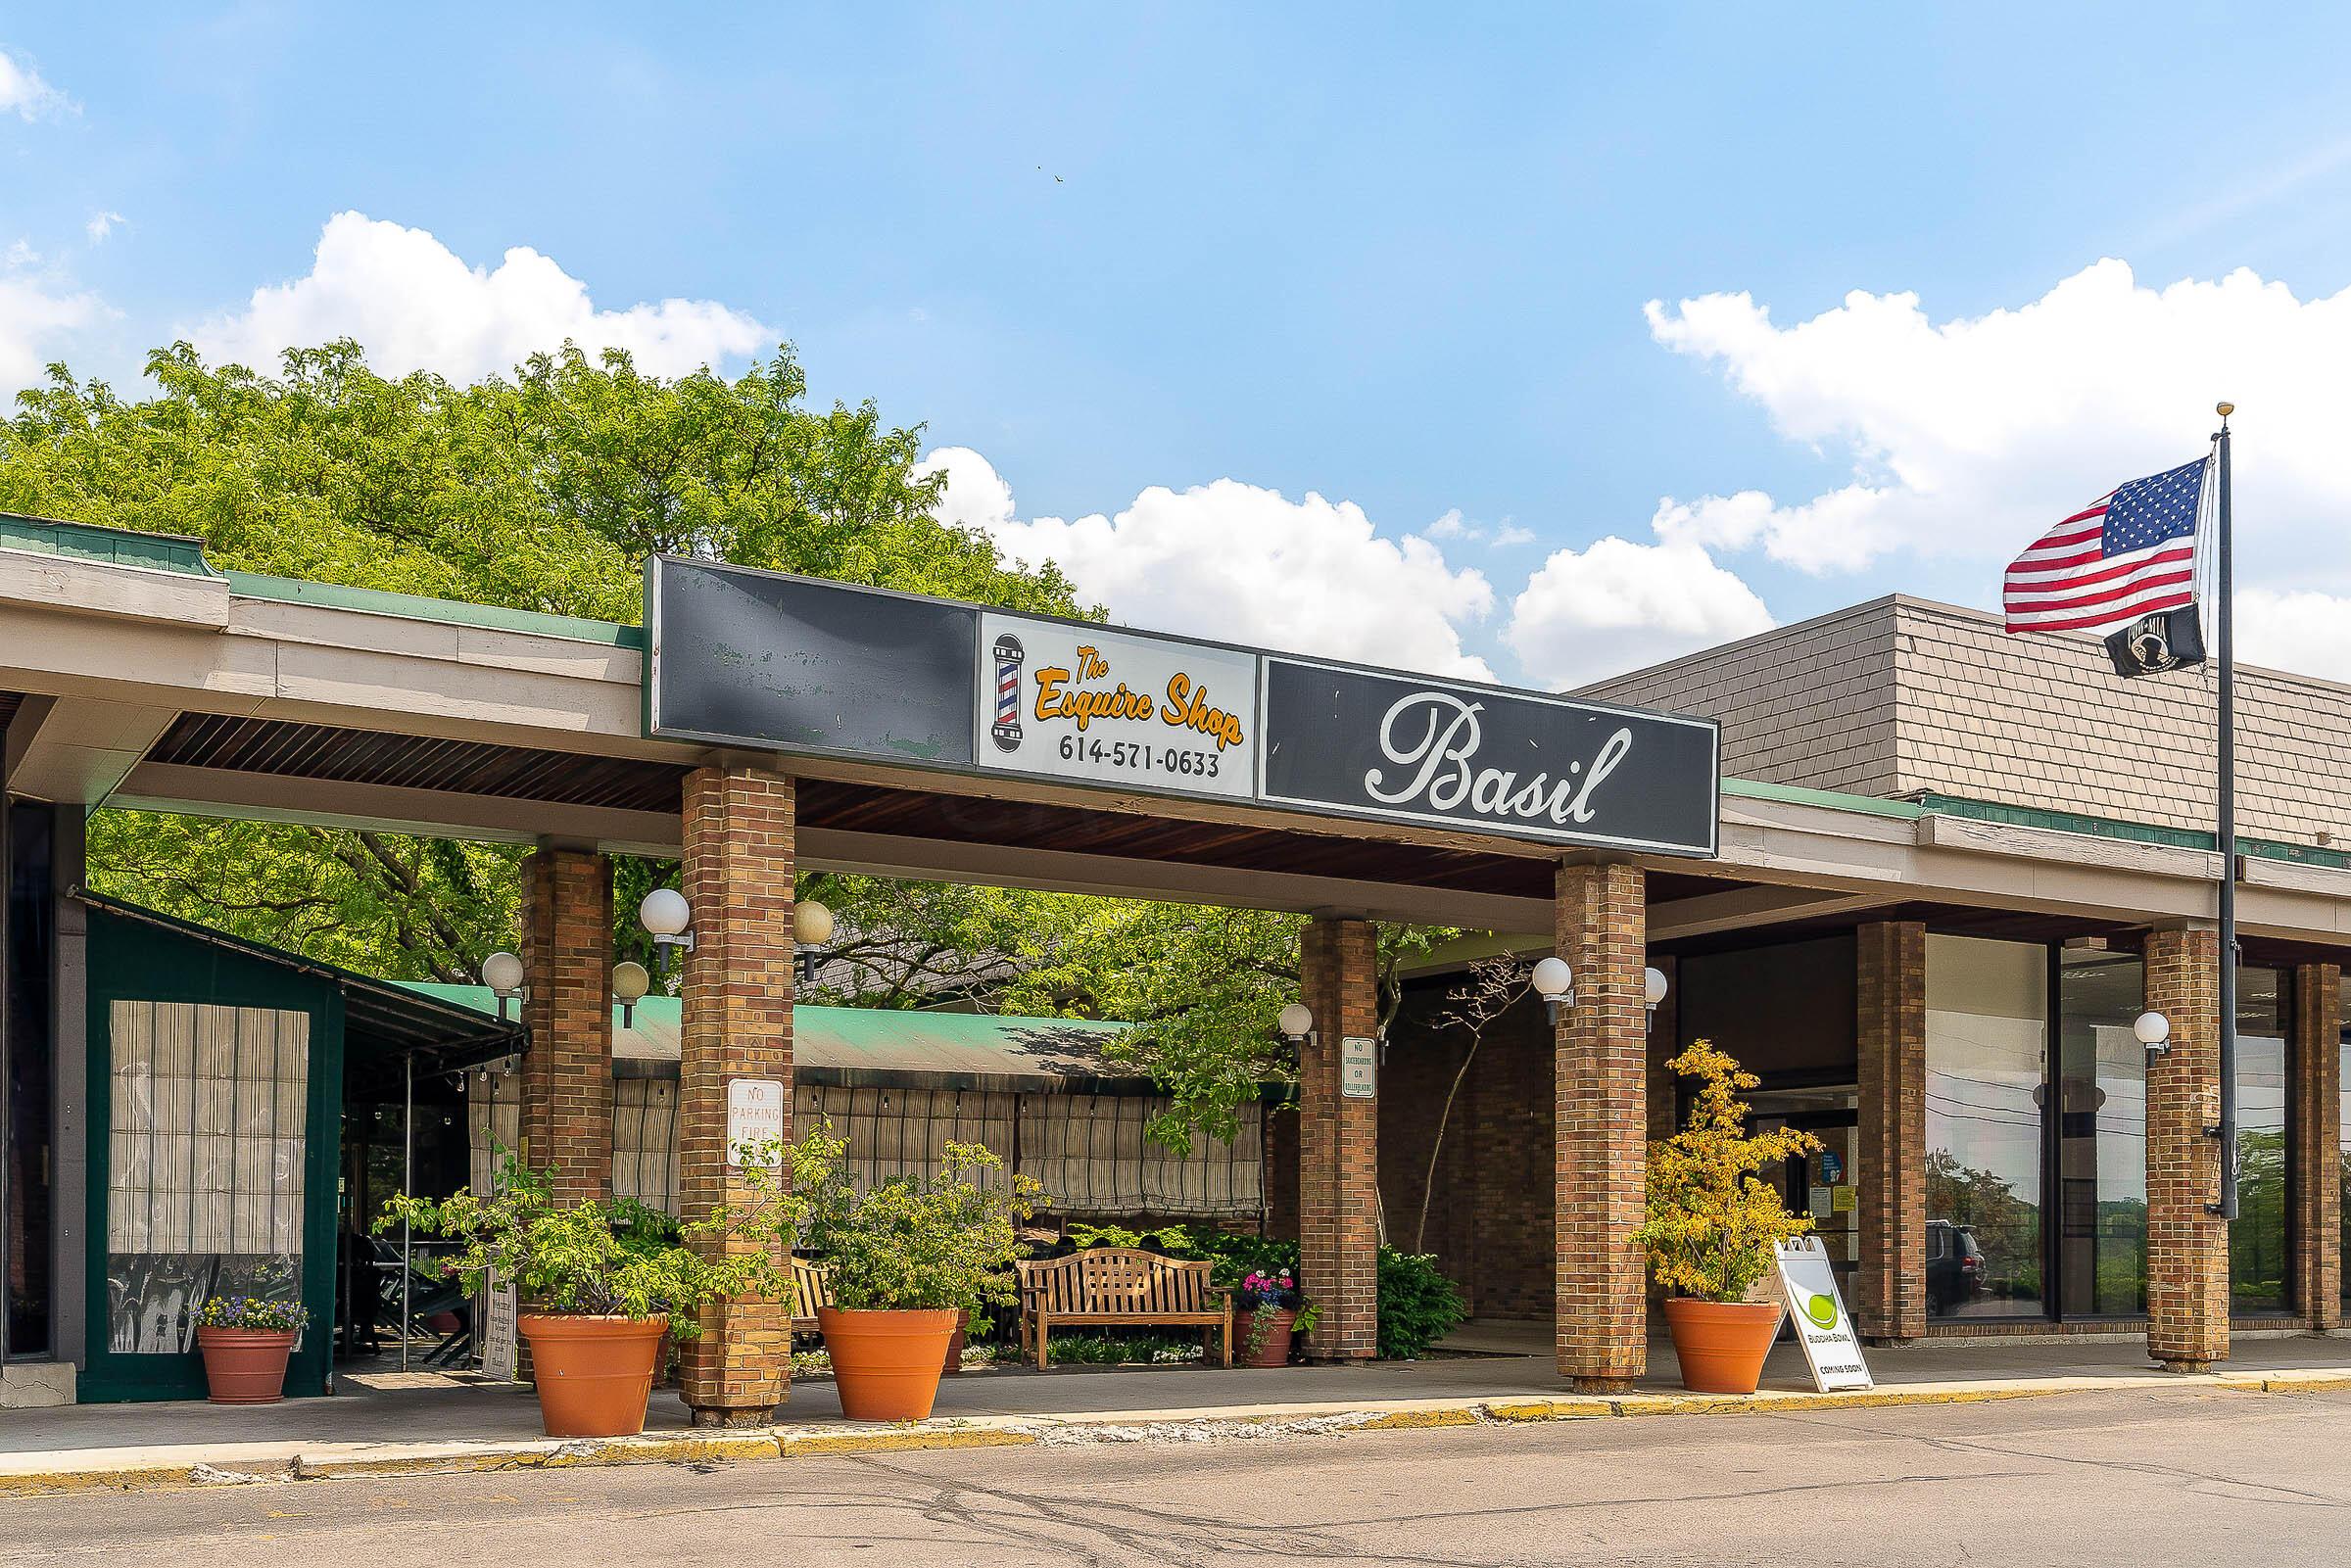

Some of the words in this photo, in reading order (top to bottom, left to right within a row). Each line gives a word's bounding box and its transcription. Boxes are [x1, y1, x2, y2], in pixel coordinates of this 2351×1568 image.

[1077, 644, 1109, 684] The
[1034, 666, 1154, 732] Esquire
[1160, 672, 1244, 751] Shop
[1059, 734, 1220, 779] 614-571-0633
[1365, 691, 1633, 825] Basil
[1355, 1043, 1363, 1052] NO
[1354, 1069, 1364, 1078] OR
[747, 1088, 764, 1102] NO
[733, 1107, 779, 1120] PARKING
[742, 1126, 769, 1139] FIRE
[1833, 1333, 1851, 1343] BOWL
[1819, 1365, 1844, 1374] COMING
[1844, 1364, 1863, 1373] SOON
